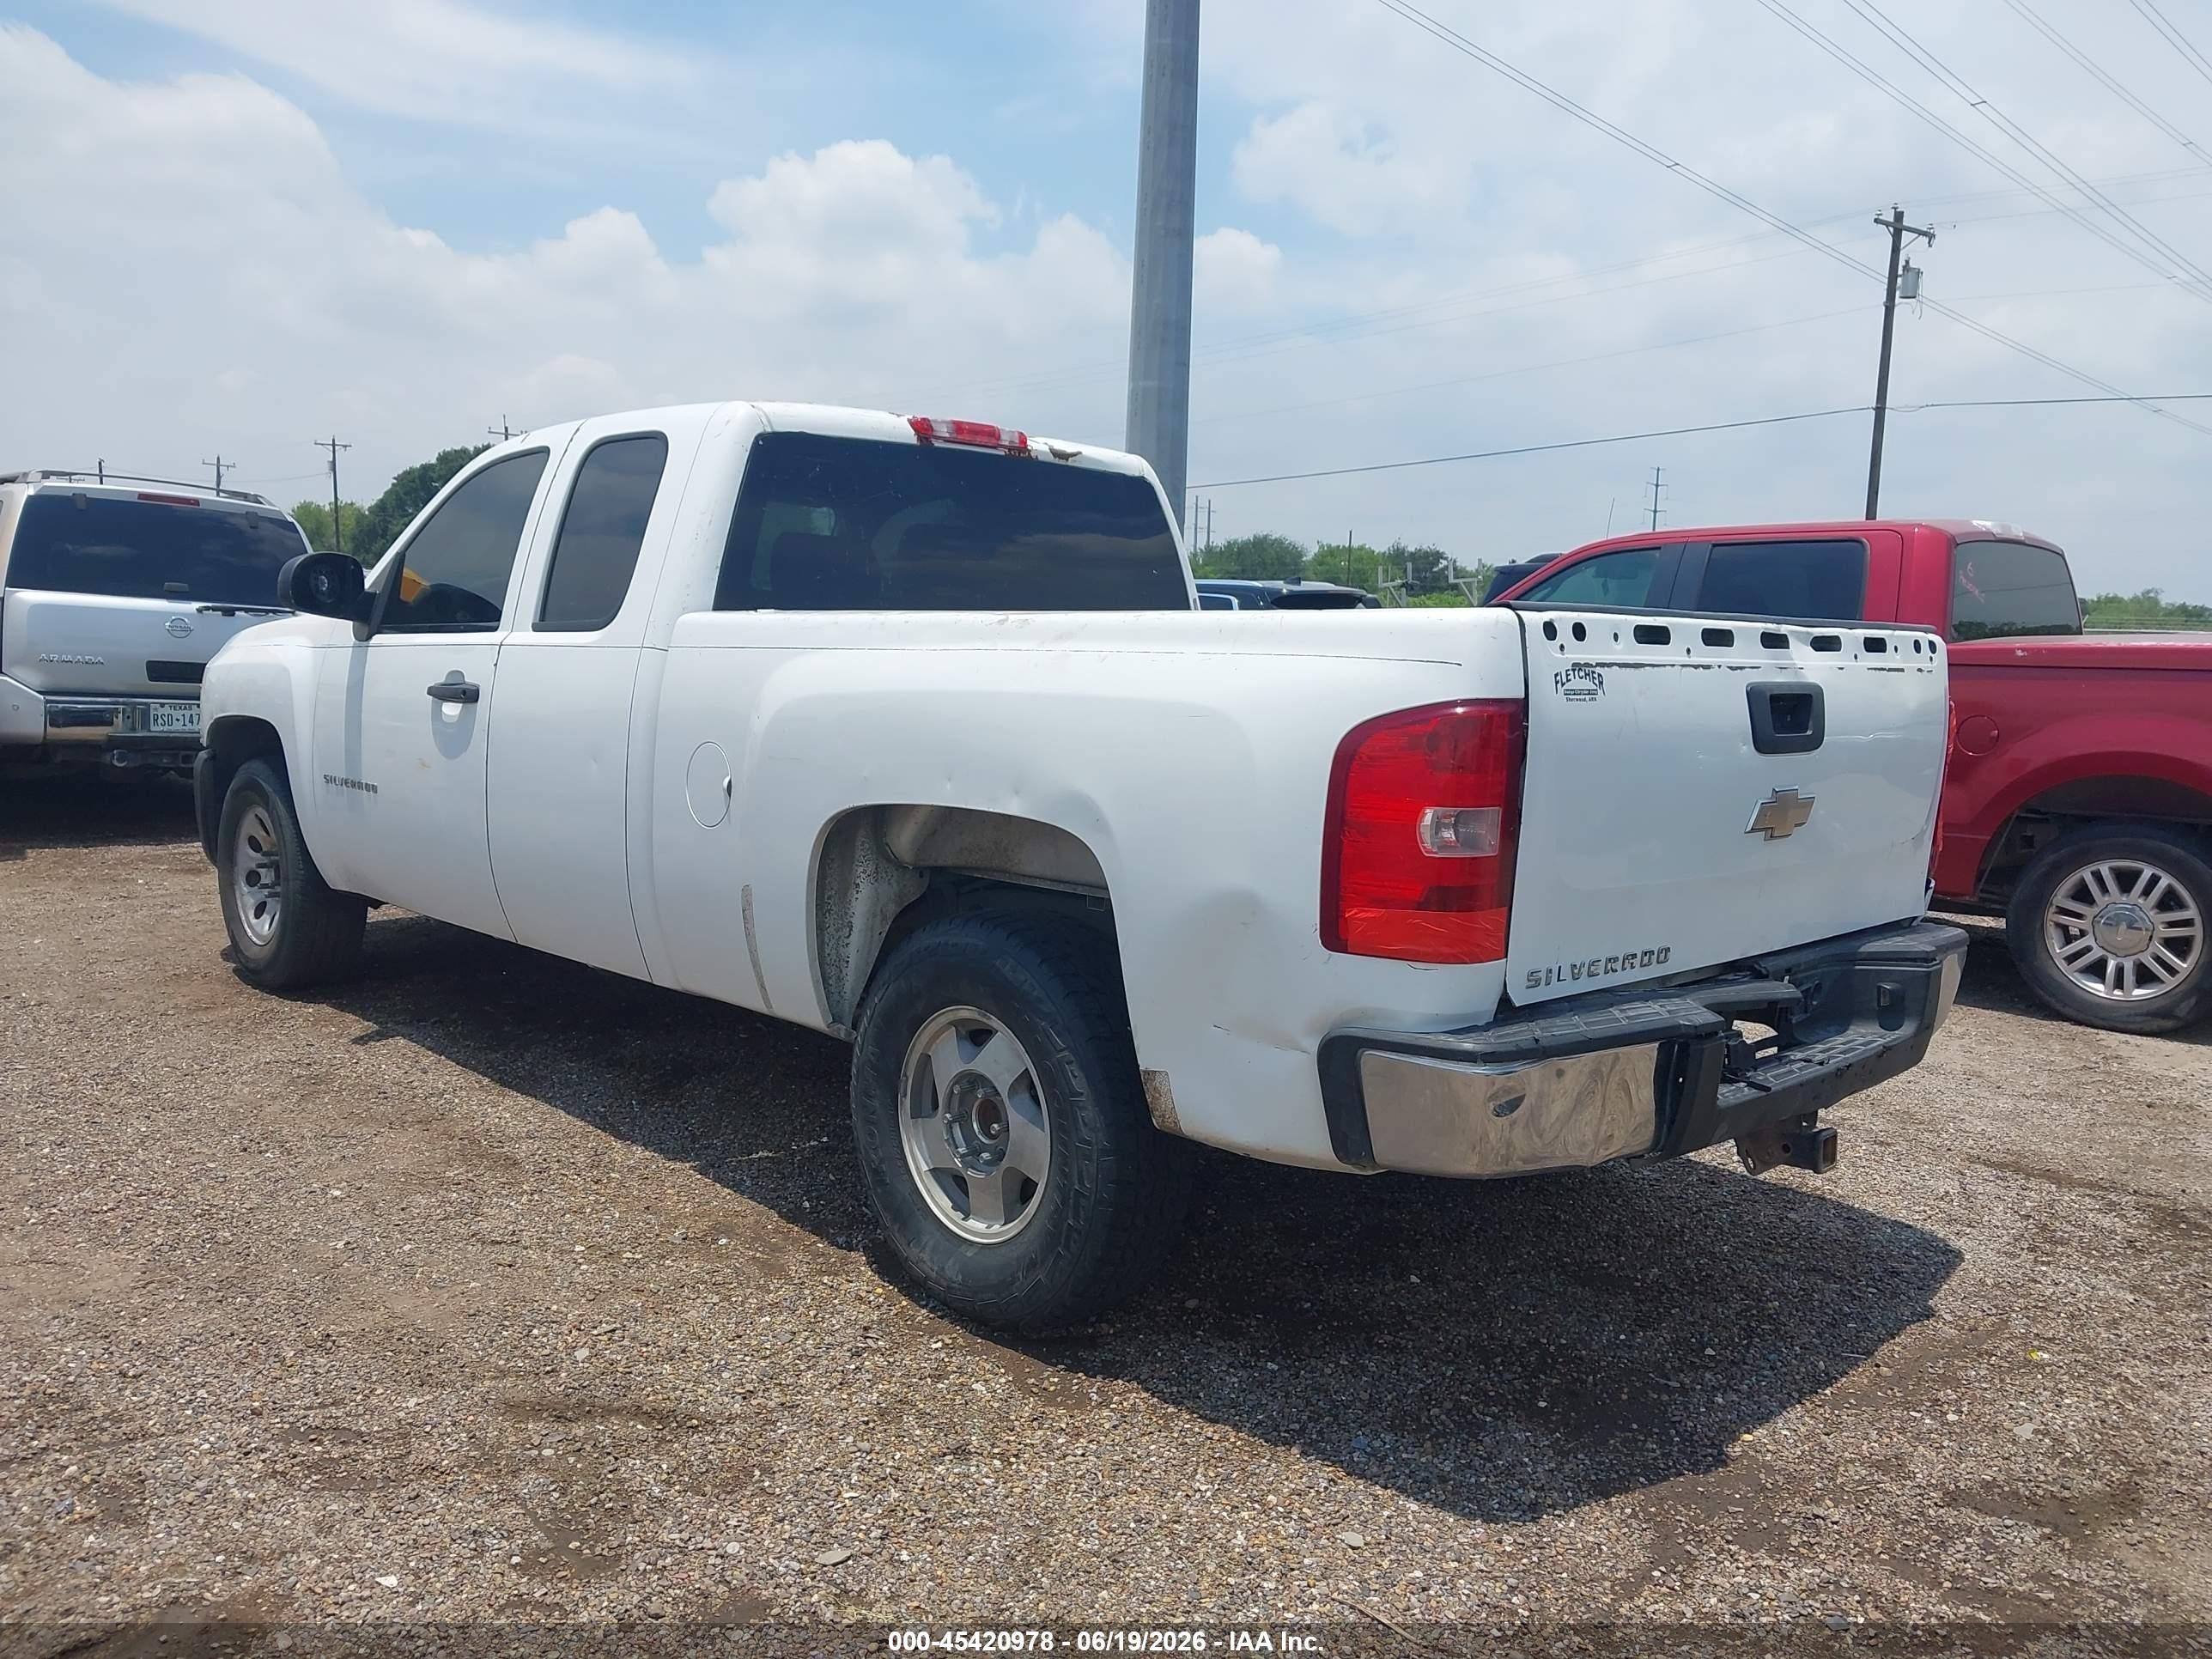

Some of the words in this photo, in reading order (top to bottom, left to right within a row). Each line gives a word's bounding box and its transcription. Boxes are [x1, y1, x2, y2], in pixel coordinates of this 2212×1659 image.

[39, 653, 104, 665] ARMADA
[1553, 667, 1606, 696] FLETCHER
[181, 714, 201, 726] 147
[323, 774, 378, 794] SILVERADO
[1525, 945, 1672, 989] SILVERADO
